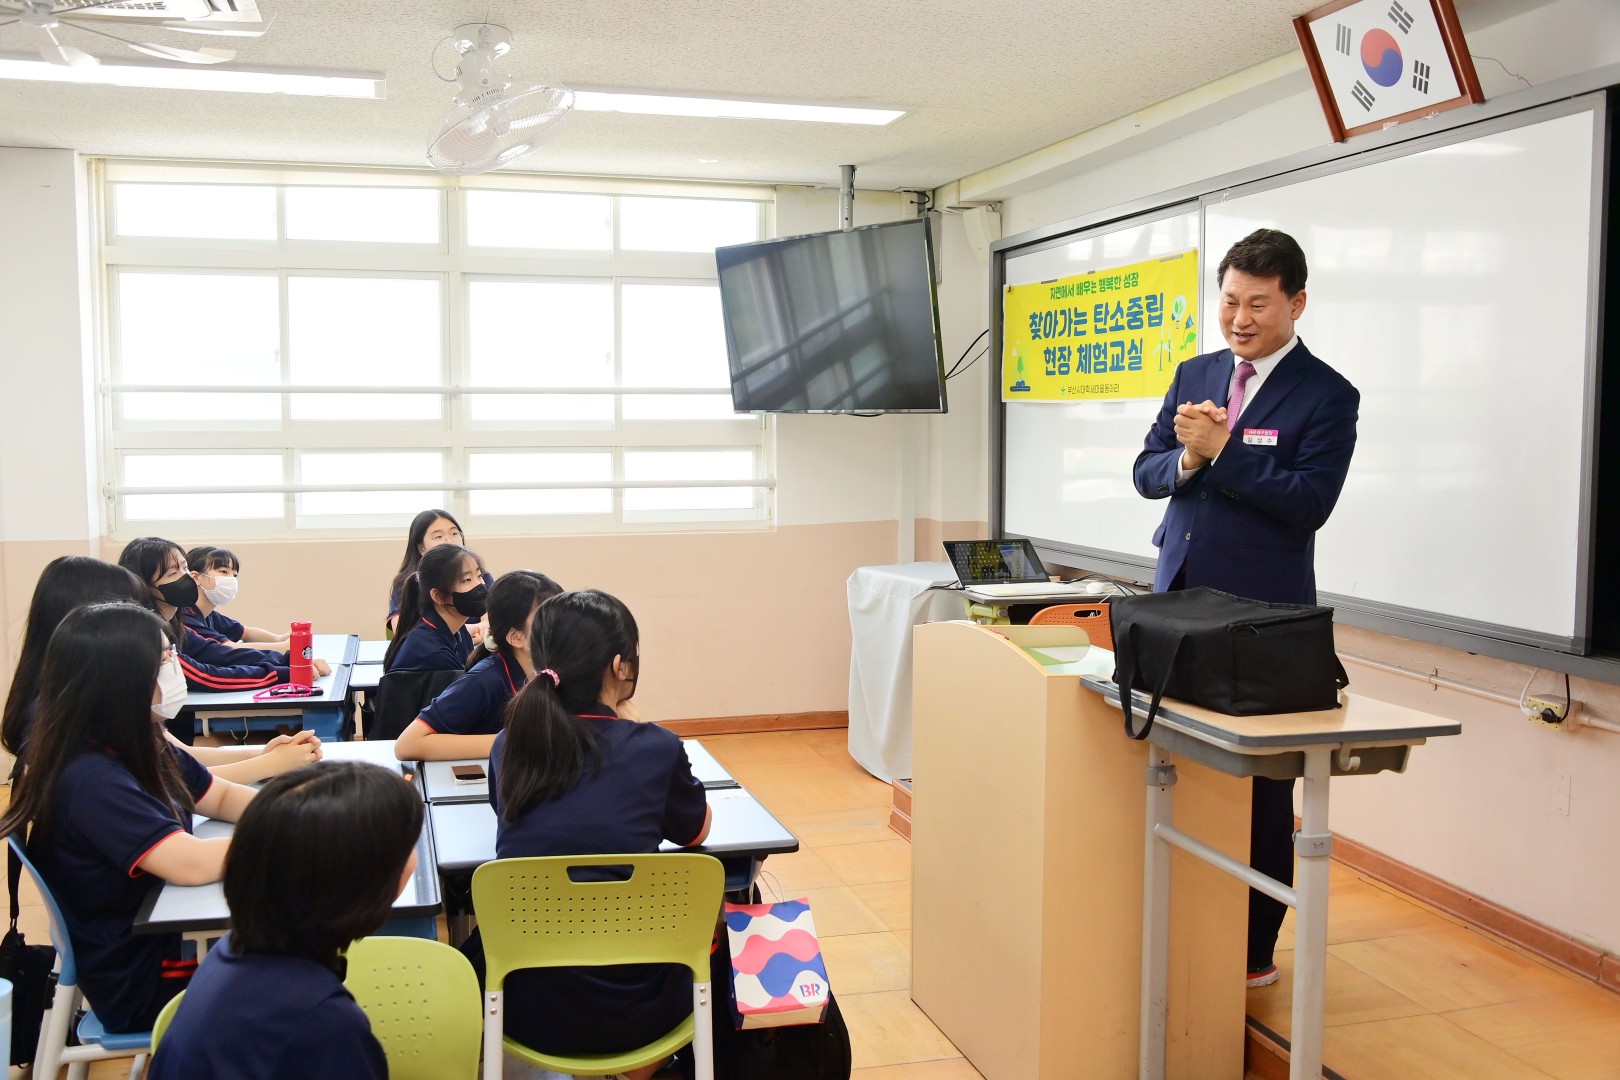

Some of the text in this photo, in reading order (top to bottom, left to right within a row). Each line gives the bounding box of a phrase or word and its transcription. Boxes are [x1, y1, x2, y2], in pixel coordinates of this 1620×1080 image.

[1050, 272, 1139, 300] 자연에서 배우는 행복한 성장
[1029, 292, 1164, 341] 찾아가는 탄소중립
[1043, 337, 1144, 376] 현장 체험교실
[799, 983, 821, 998] BR
